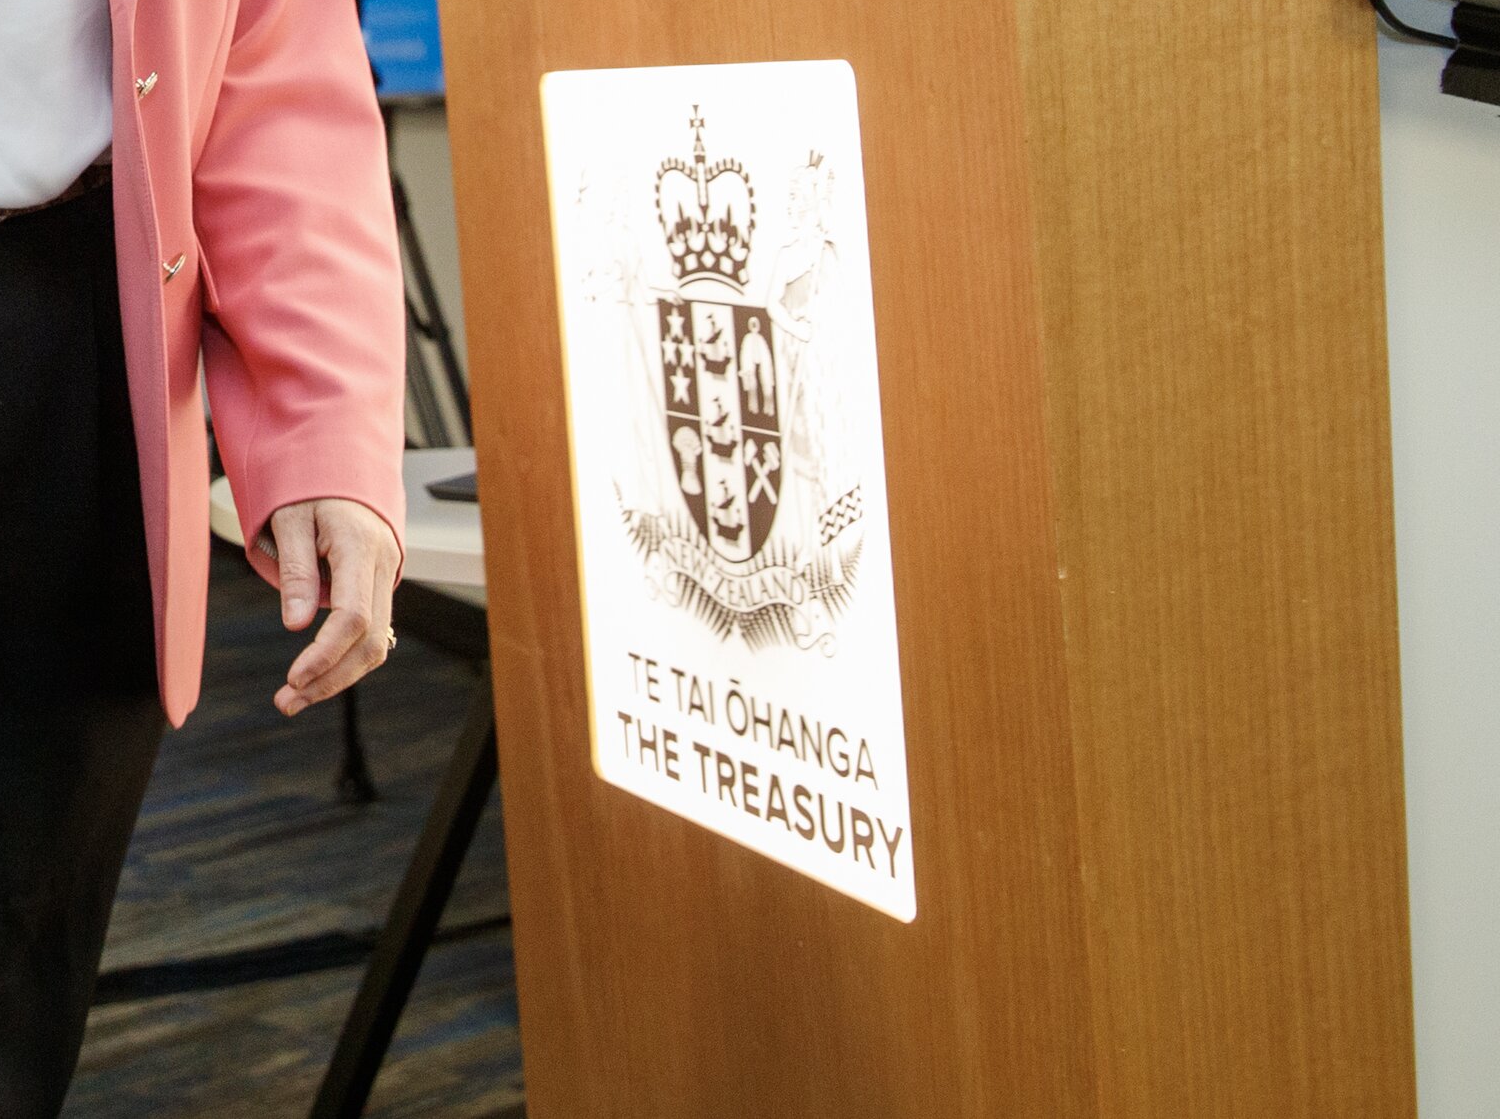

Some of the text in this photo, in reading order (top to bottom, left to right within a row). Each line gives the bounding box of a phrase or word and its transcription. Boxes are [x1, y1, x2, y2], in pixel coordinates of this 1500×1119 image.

[662, 540, 804, 607] NEW ZEALAND
[628, 652, 878, 790] TE TAI ŌHANGA
[617, 710, 903, 879] THE TREASURY
